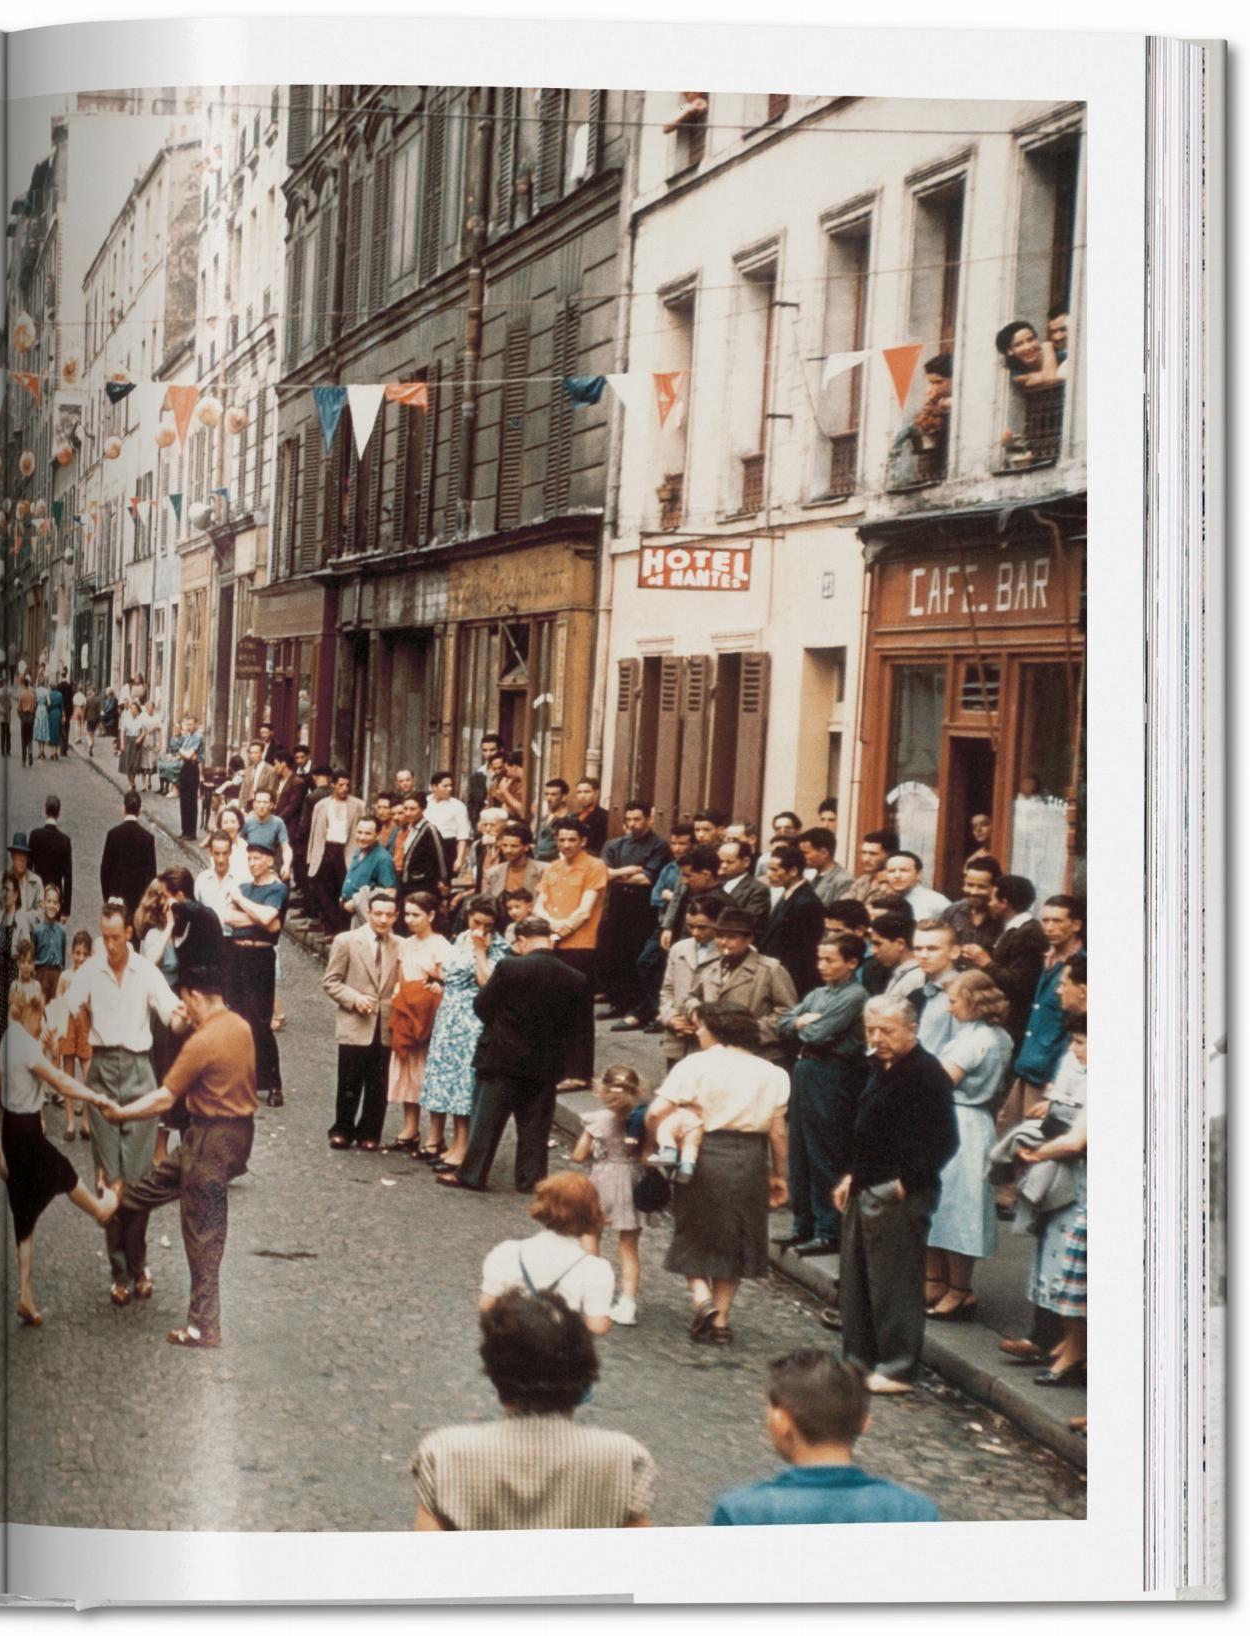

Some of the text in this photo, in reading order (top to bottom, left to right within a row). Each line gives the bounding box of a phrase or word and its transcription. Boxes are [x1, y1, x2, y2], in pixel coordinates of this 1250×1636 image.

[642, 549, 749, 581] HOTEL
[670, 569, 742, 588] NANTES
[995, 557, 1050, 612] BAR
